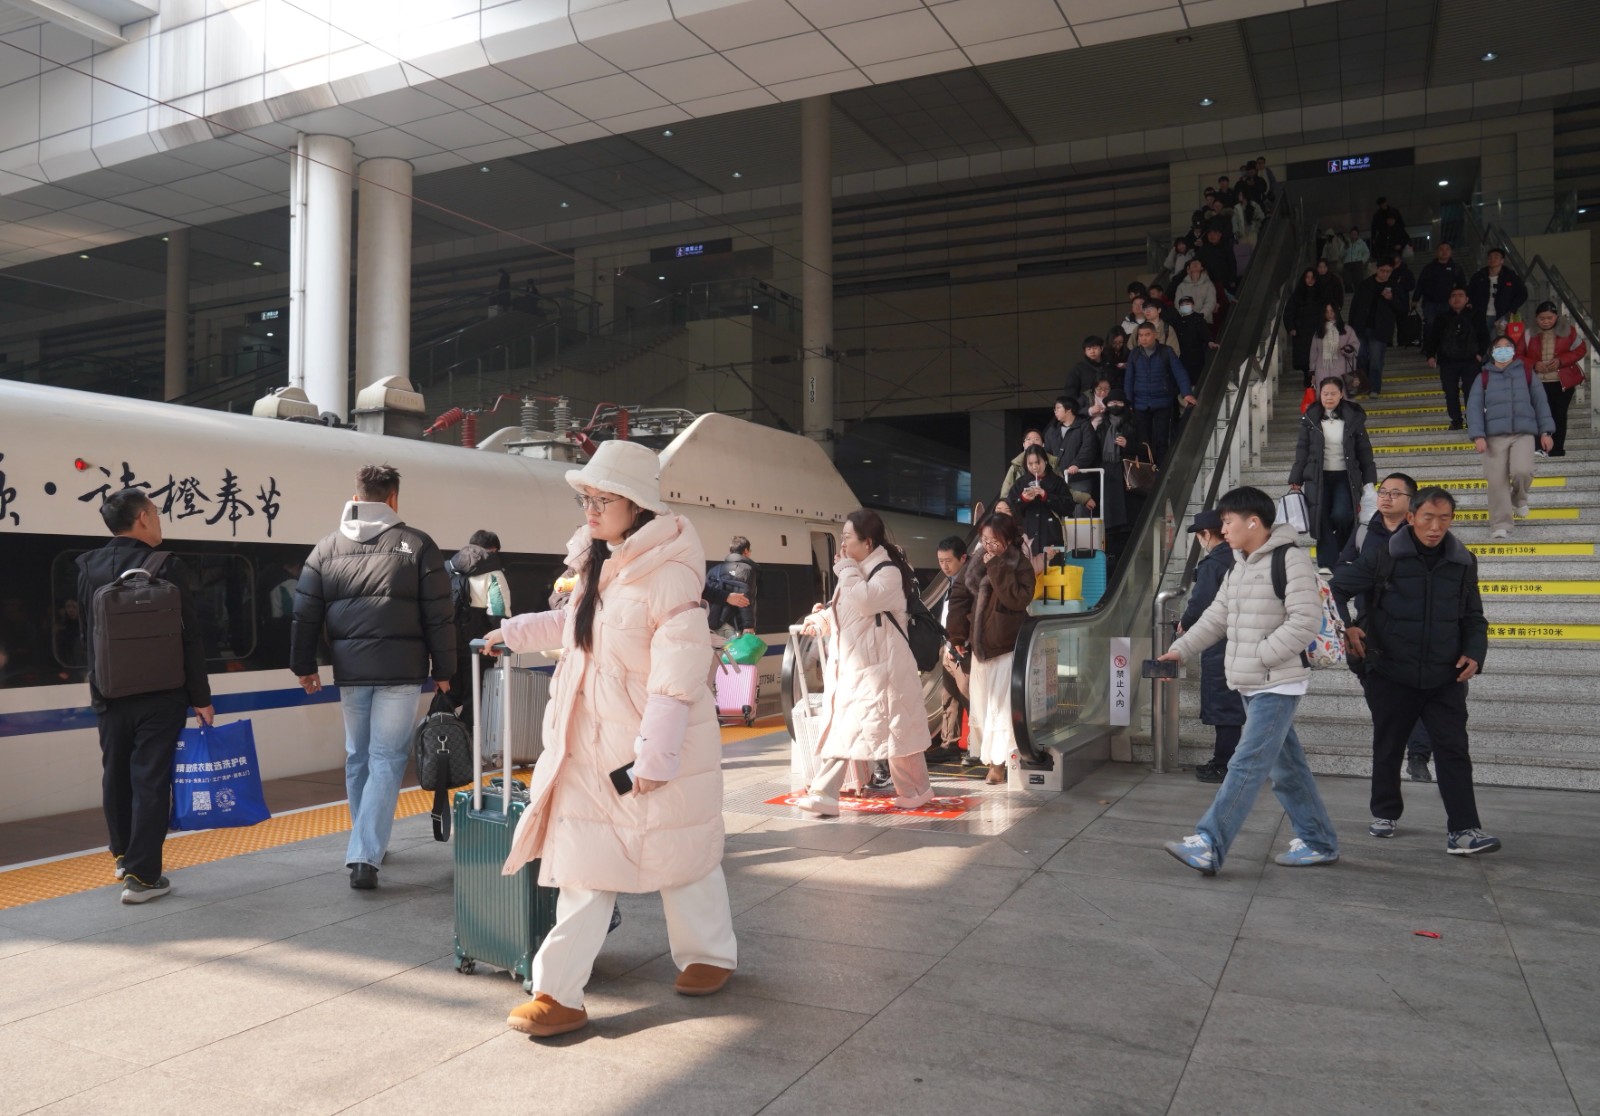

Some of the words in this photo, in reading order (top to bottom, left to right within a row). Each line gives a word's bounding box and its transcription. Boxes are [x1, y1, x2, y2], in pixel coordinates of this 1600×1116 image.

[1468, 546, 1537, 555] 旅客请前行130米
[1477, 584, 1543, 593] 客请前行130米
[1115, 670, 1125, 708] 禁止入内
